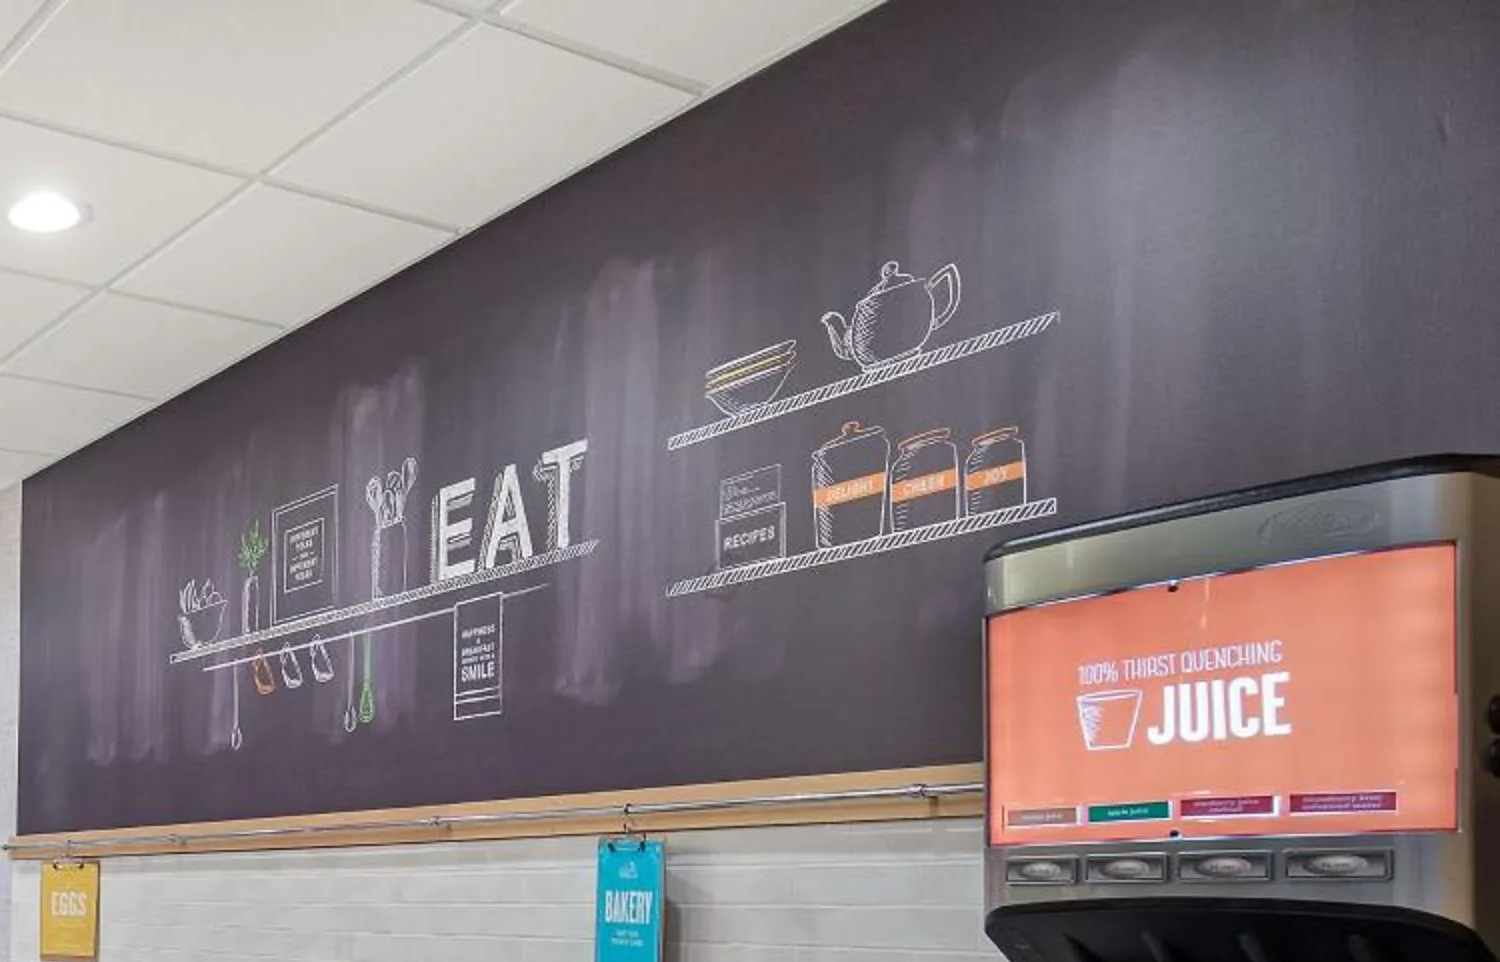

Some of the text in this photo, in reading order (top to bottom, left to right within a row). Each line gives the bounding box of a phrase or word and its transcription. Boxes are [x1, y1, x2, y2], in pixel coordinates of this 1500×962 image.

[903, 475, 944, 495] CHEER
[983, 470, 1008, 484] JOY
[827, 480, 874, 502] DELIGHT
[431, 439, 588, 582] EAT
[723, 525, 775, 551] RECIPES
[461, 661, 495, 682] SMILE
[1077, 639, 1283, 685] 100% THIRST QUENCHING
[1147, 672, 1292, 745] JUICE
[51, 891, 87, 916] EGGS
[605, 889, 653, 924] BAKERY
